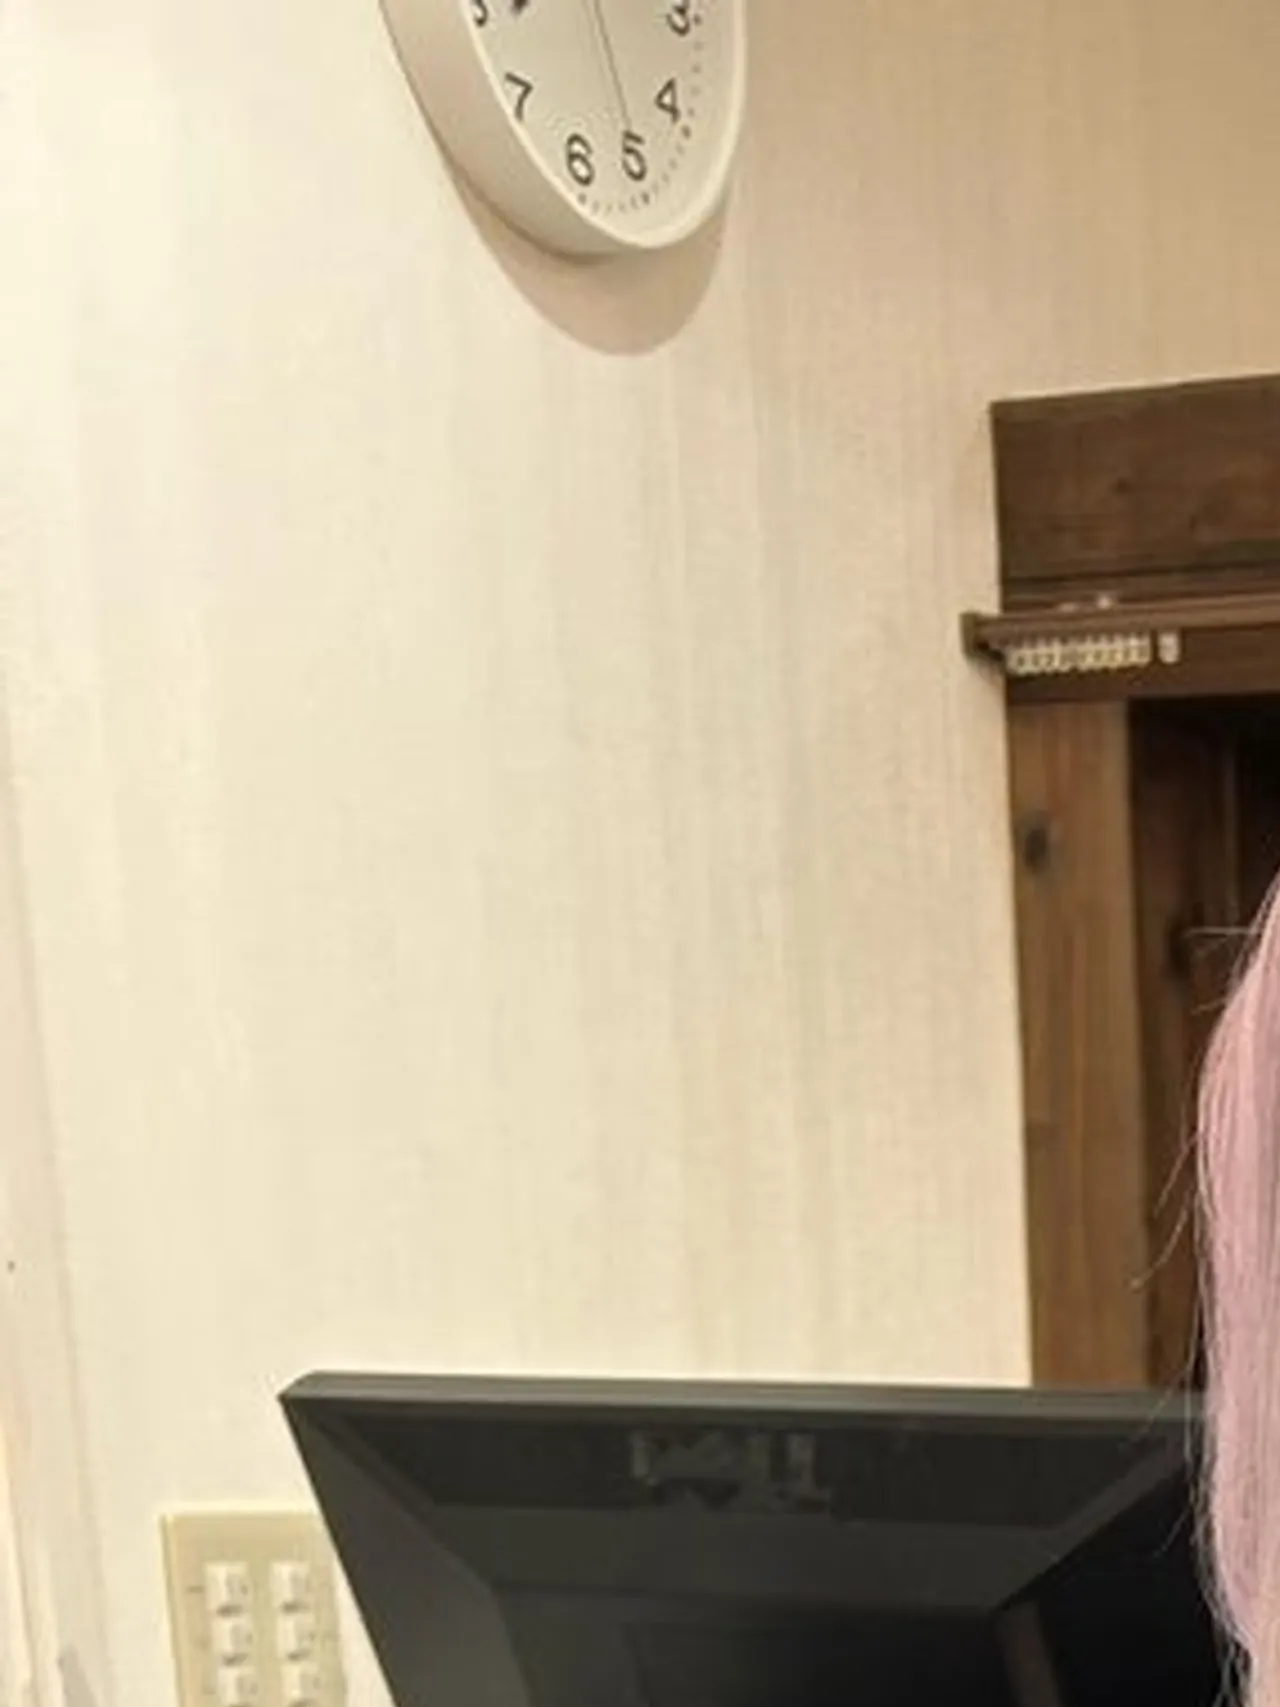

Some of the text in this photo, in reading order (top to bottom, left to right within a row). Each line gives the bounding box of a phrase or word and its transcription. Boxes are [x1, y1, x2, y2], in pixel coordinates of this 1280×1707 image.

[504, 73, 533, 121] 7
[655, 78, 681, 123] 4
[565, 133, 594, 186] 6
[622, 130, 647, 182] 5
